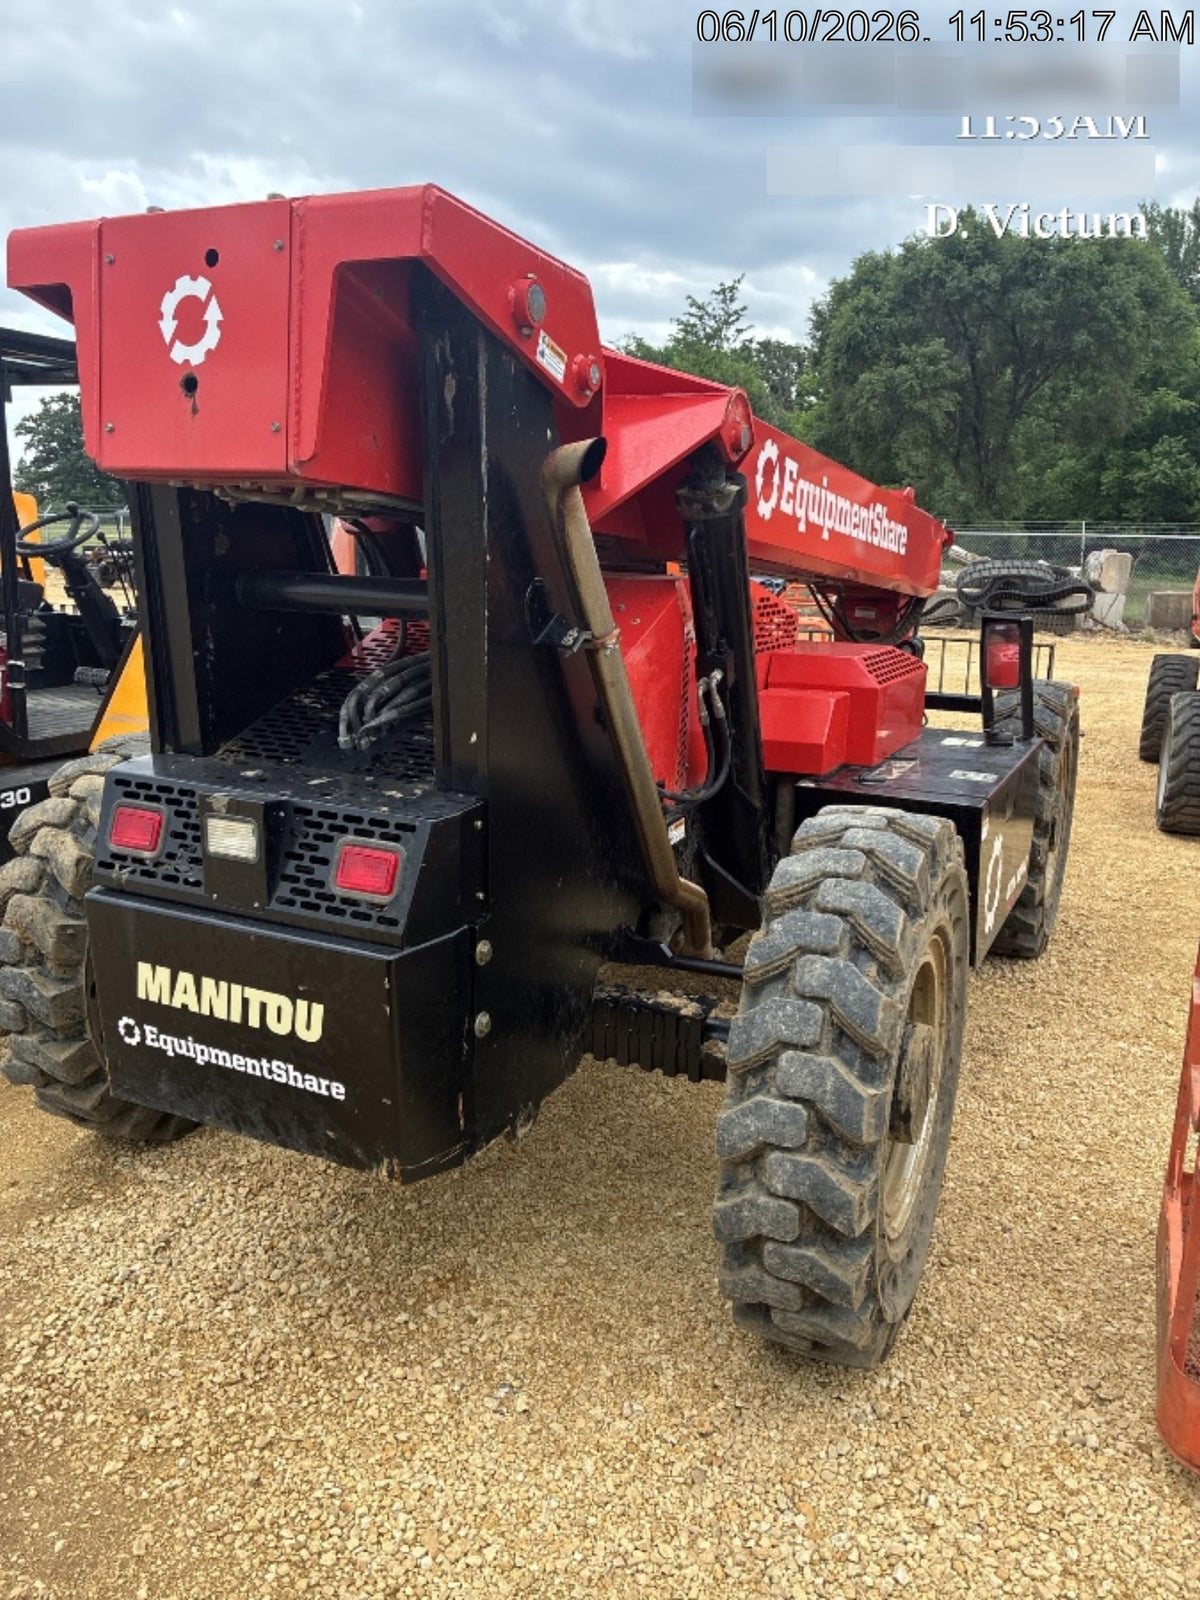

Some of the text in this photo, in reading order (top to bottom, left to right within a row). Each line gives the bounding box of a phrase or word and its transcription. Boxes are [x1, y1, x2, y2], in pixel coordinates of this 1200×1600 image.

[780, 456, 908, 555] EquipmentShare
[137, 961, 325, 1043] MANITOU
[143, 1023, 346, 1101] EquipmentShare
